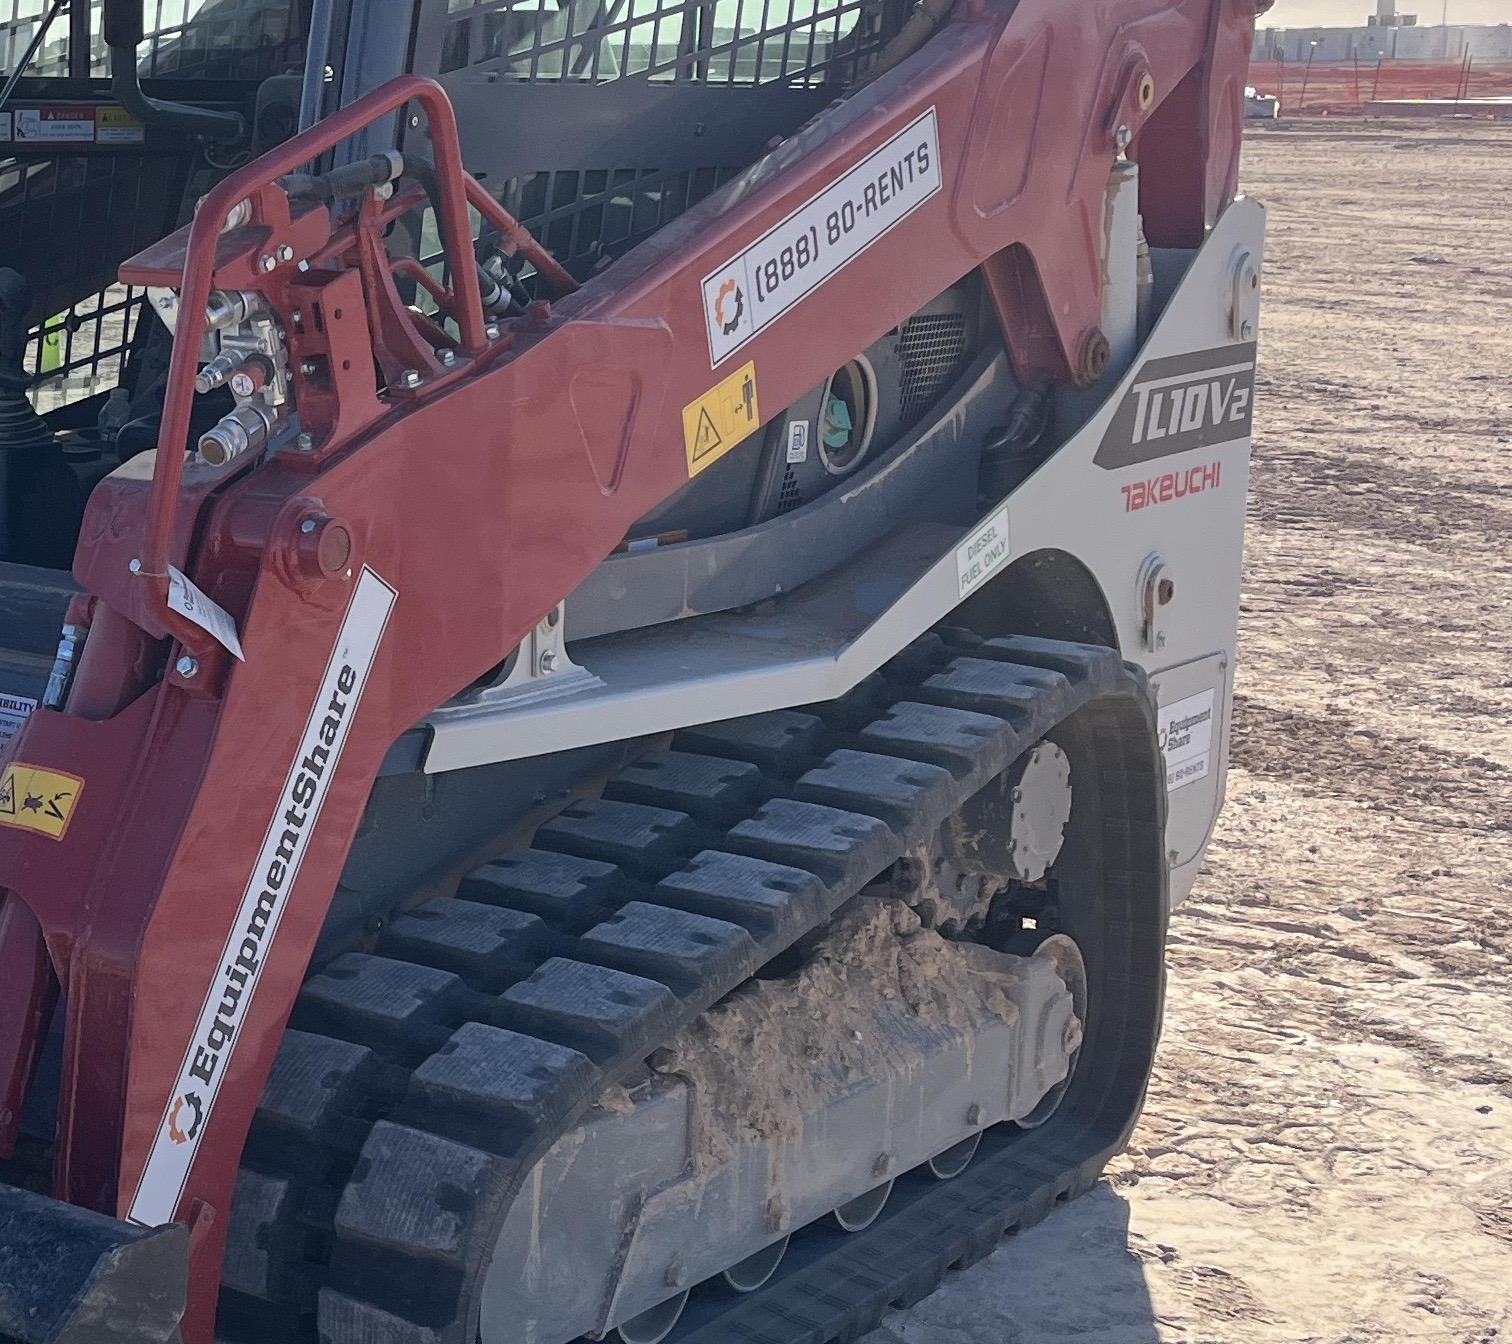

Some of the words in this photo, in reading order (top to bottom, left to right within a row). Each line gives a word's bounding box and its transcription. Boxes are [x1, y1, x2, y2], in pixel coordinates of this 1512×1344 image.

[755, 226, 819, 302] (888)
[826, 141, 931, 246] 80-RENTS
[1132, 361, 1254, 444] TL10V2
[1121, 461, 1221, 513] TAKEUCHI
[961, 562, 983, 590] FUEL
[984, 537, 1007, 568] ONLY
[968, 526, 998, 561] DIESEL
[187, 662, 357, 1088] EquipmentShare
